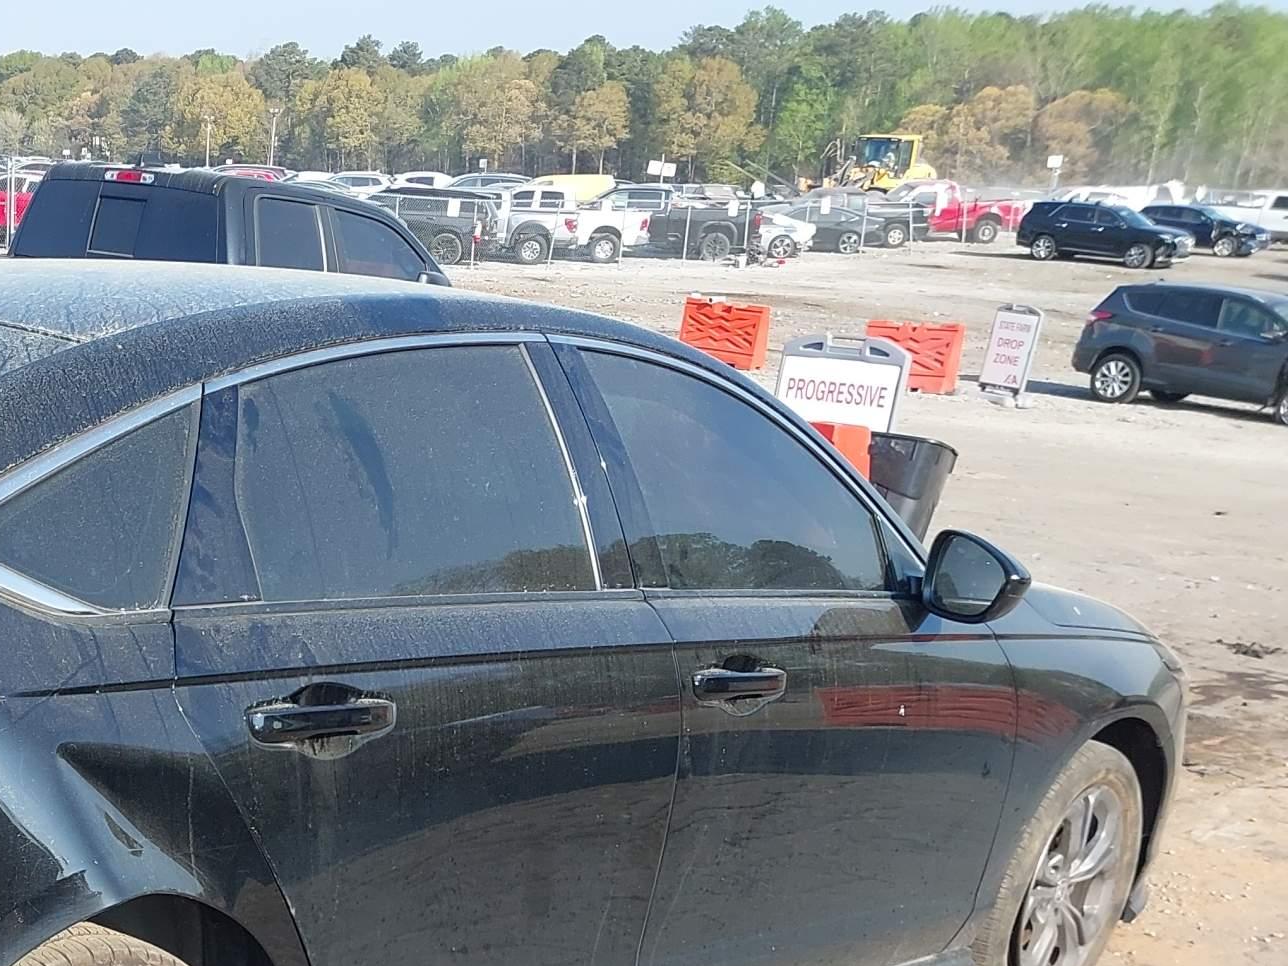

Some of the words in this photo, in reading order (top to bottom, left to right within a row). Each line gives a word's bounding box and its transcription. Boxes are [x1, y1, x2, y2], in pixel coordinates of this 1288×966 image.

[997, 337, 1025, 350] DROP
[993, 353, 1020, 367] ZONE
[786, 377, 888, 408] PROGRESSIVE
